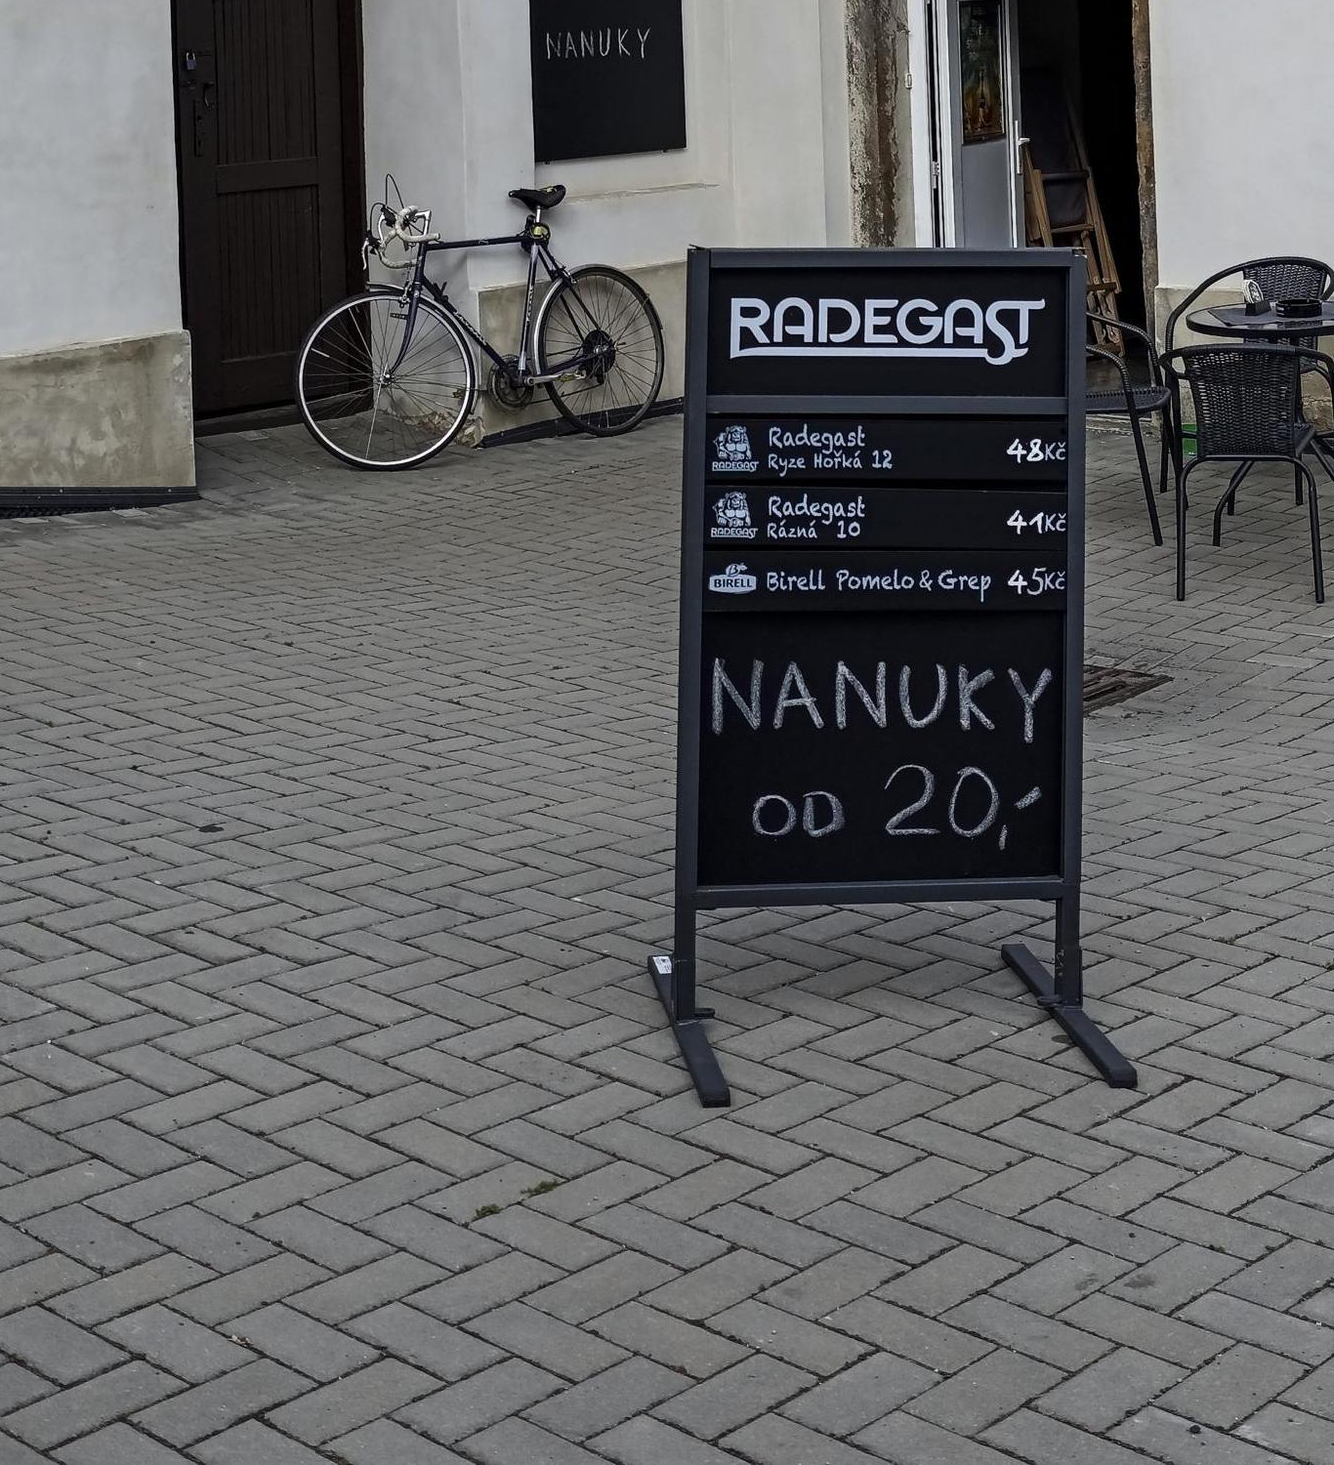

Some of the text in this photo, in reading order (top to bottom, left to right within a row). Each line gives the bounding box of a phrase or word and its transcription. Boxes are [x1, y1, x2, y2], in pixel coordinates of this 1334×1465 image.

[546, 28, 651, 59] NANUKY
[730, 297, 1045, 365] RADEGAST
[768, 424, 865, 455] Radegast
[712, 461, 759, 472] RADEGAST
[768, 450, 893, 477] Ryze Hořká 12
[768, 494, 865, 524] Radegast
[711, 528, 758, 539] RADEGAST
[767, 521, 860, 539] Rázná 10
[714, 578, 753, 588] BIRELL
[767, 569, 825, 592] Birell
[836, 569, 914, 591] Pomelo
[938, 570, 991, 602] Grep
[712, 657, 1052, 743] NANUKY
